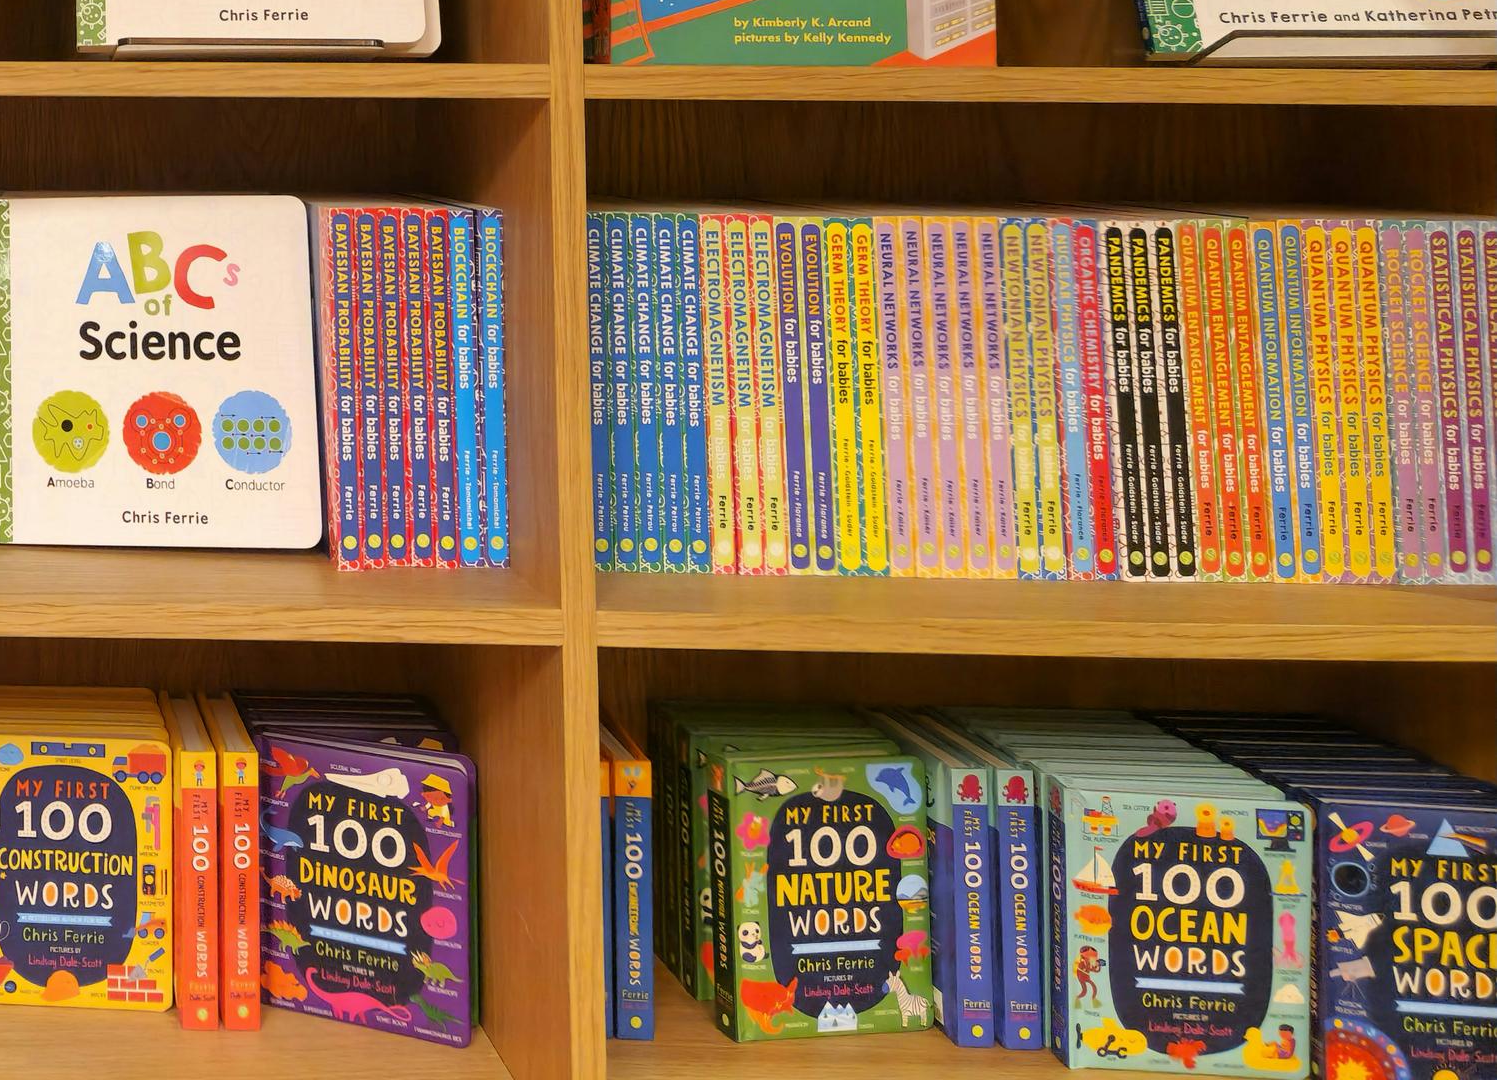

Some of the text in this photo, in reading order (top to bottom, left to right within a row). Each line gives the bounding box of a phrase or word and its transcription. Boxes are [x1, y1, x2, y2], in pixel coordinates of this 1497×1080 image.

[219, 9, 309, 21] Chris Ferrie
[734, 17, 871, 29] by Kimberly K. Arcand
[1219, 9, 1457, 24] Chris Ferrie and Katherina
[1107, 237, 1130, 393] PANDEMICS for babies
[335, 223, 352, 461] BAYESIAN PROBABILITY for babies
[1335, 241, 1361, 478] QUANTUM PHYSICS for babies
[16, 779, 110, 799] MY FIRST
[15, 801, 112, 842] 100
[786, 805, 874, 824] MY FIRST
[307, 815, 407, 868] 100
[785, 825, 878, 867] 100
[16, 881, 114, 909] WORDS
[300, 857, 417, 905] DINOSAUR
[776, 869, 890, 906] NATURE
[308, 892, 408, 937] WORDS
[789, 907, 882, 937] WORDS
[1130, 905, 1247, 945] OCEAN
